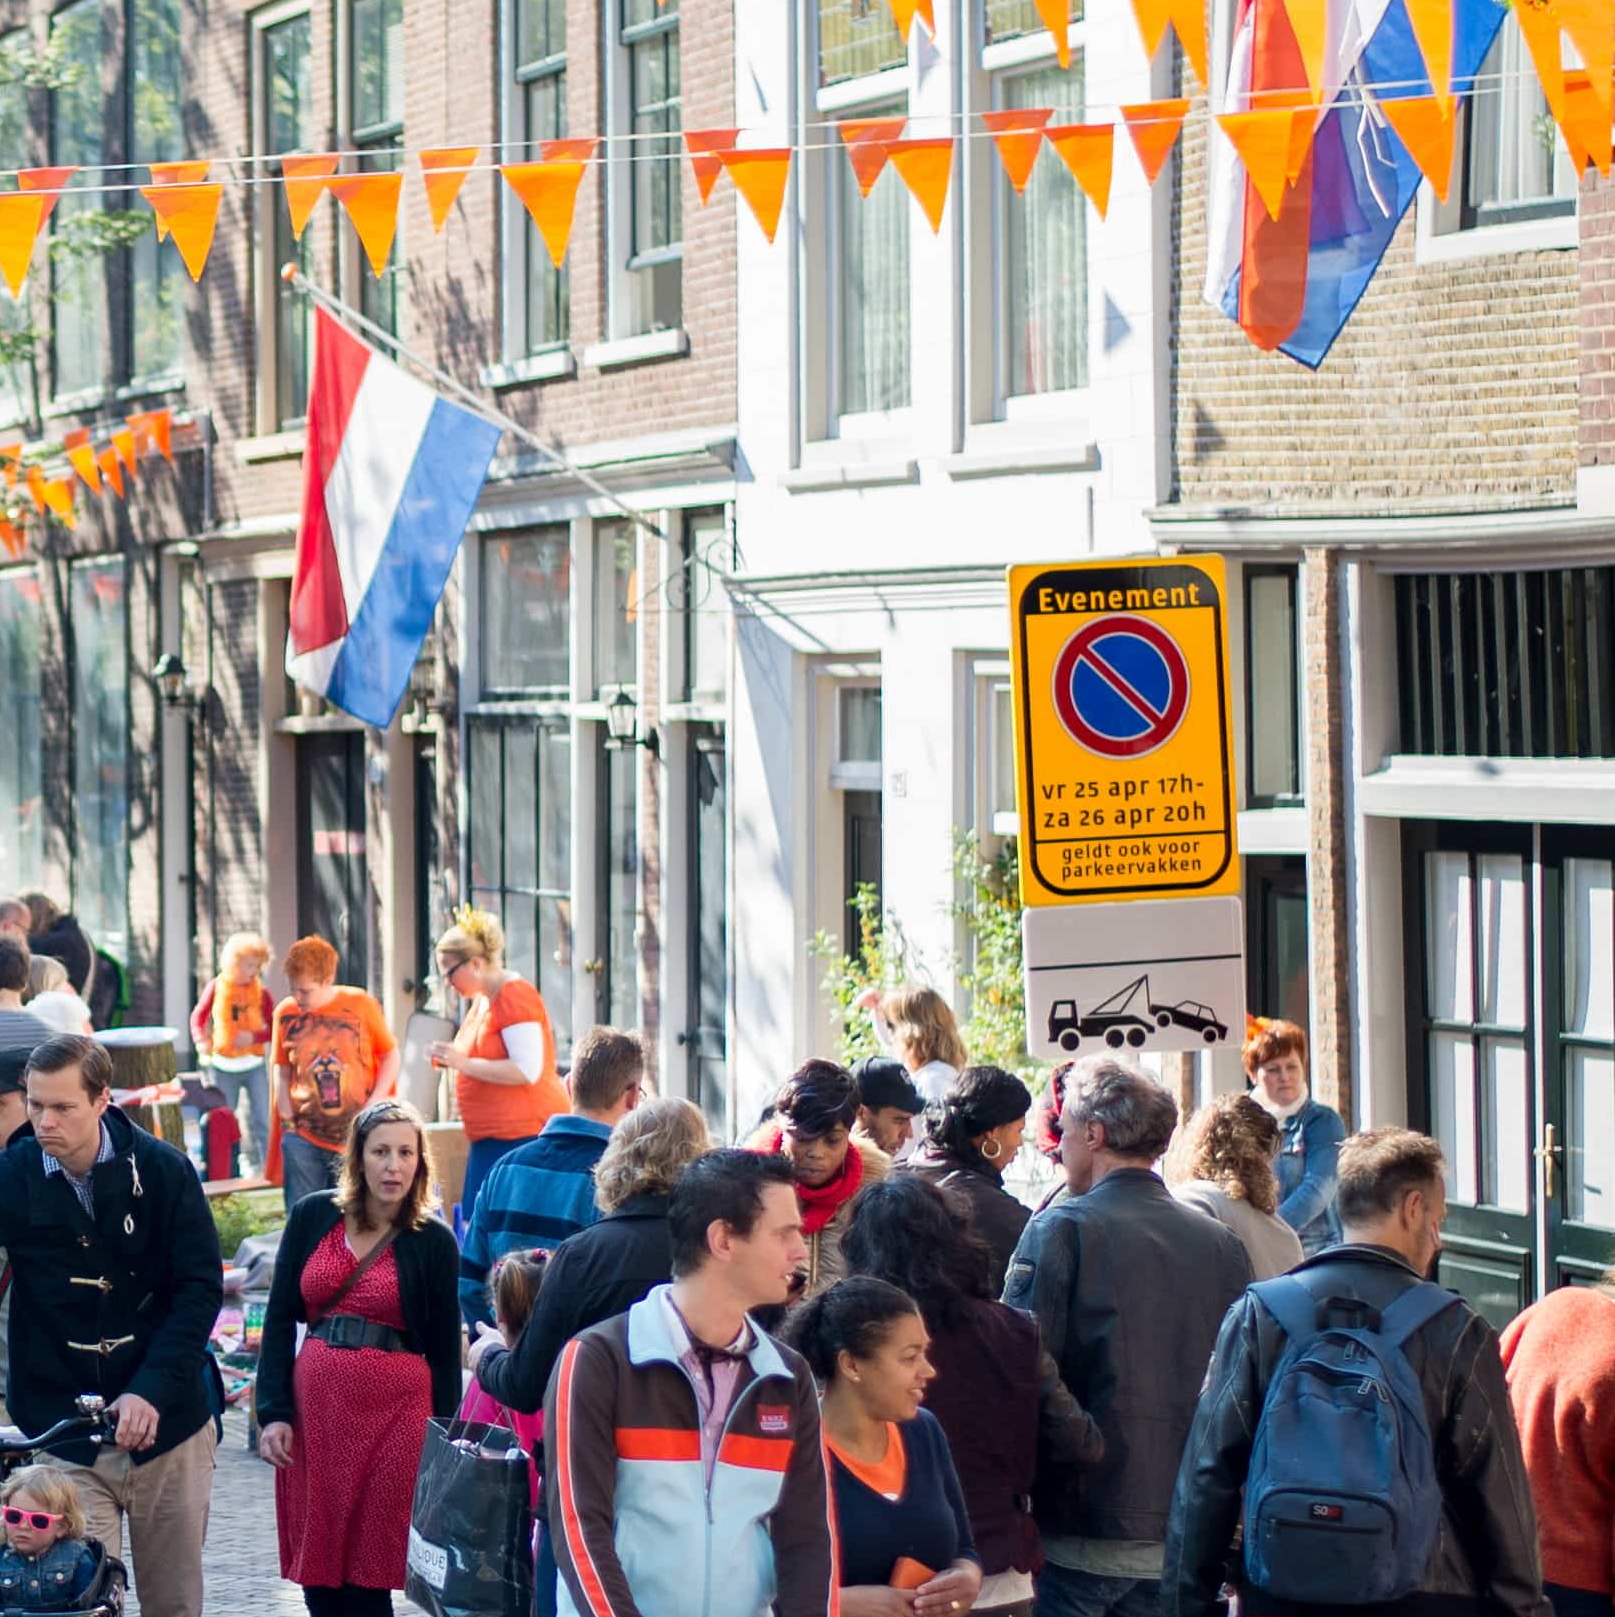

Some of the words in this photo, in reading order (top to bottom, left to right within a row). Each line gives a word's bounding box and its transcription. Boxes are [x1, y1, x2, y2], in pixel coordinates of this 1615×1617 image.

[1038, 583, 1201, 613] Evenement
[1041, 783, 1067, 800] vr
[1074, 781, 1099, 798] 25
[1107, 779, 1150, 802] apr
[1157, 773, 1204, 795] 17h-
[1043, 811, 1070, 828] za
[1079, 809, 1105, 826] 26
[1114, 807, 1155, 830] apr
[1163, 800, 1206, 823] 20h
[1061, 843, 1112, 864] geldt
[1118, 841, 1152, 858] ook
[1157, 841, 1200, 855] voor
[1061, 857, 1202, 882] parkeervakken
